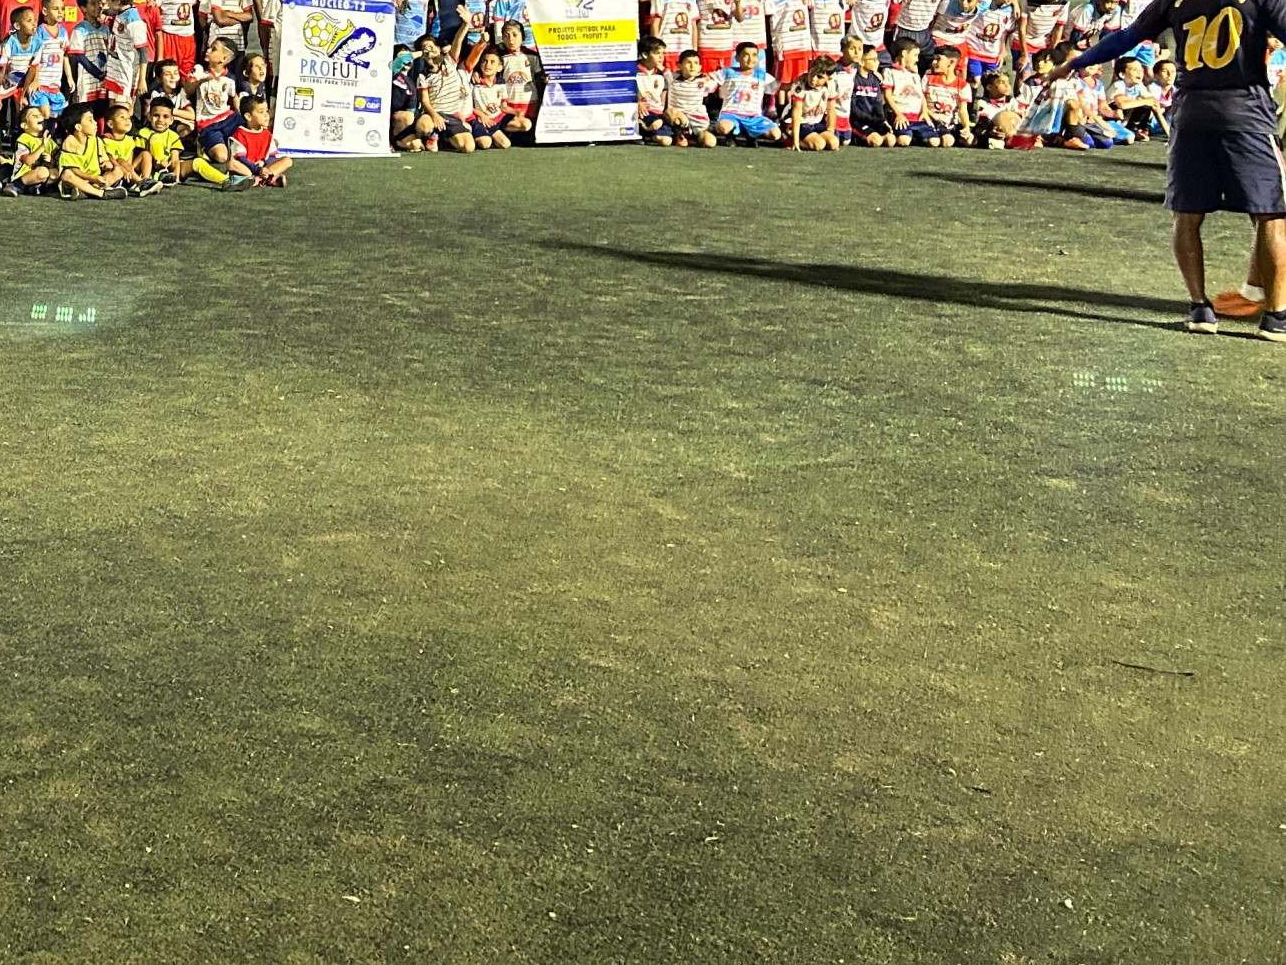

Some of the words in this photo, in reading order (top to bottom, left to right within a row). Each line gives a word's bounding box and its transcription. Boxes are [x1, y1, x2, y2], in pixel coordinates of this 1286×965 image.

[600, 24, 616, 32] PARA
[1183, 6, 1244, 71] 10
[300, 58, 358, 79] PROFUT
